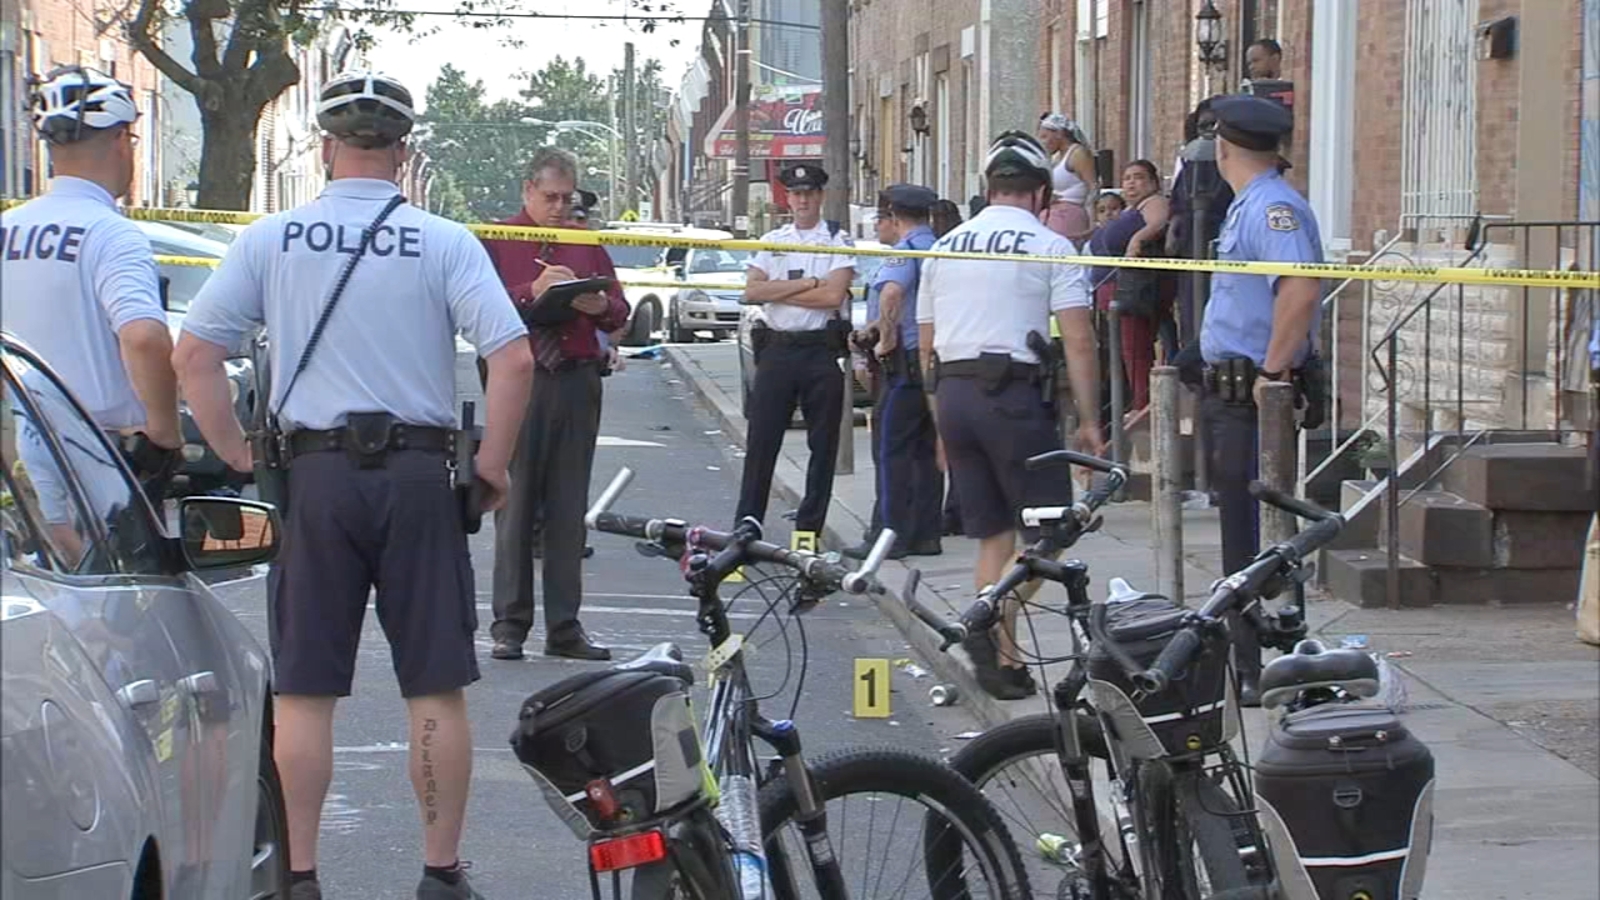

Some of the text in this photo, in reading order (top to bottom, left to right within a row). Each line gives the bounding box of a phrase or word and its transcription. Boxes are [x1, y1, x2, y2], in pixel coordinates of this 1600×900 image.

[0, 223, 86, 262] LICE
[282, 221, 421, 257] POLICE
[861, 668, 876, 707] 1
